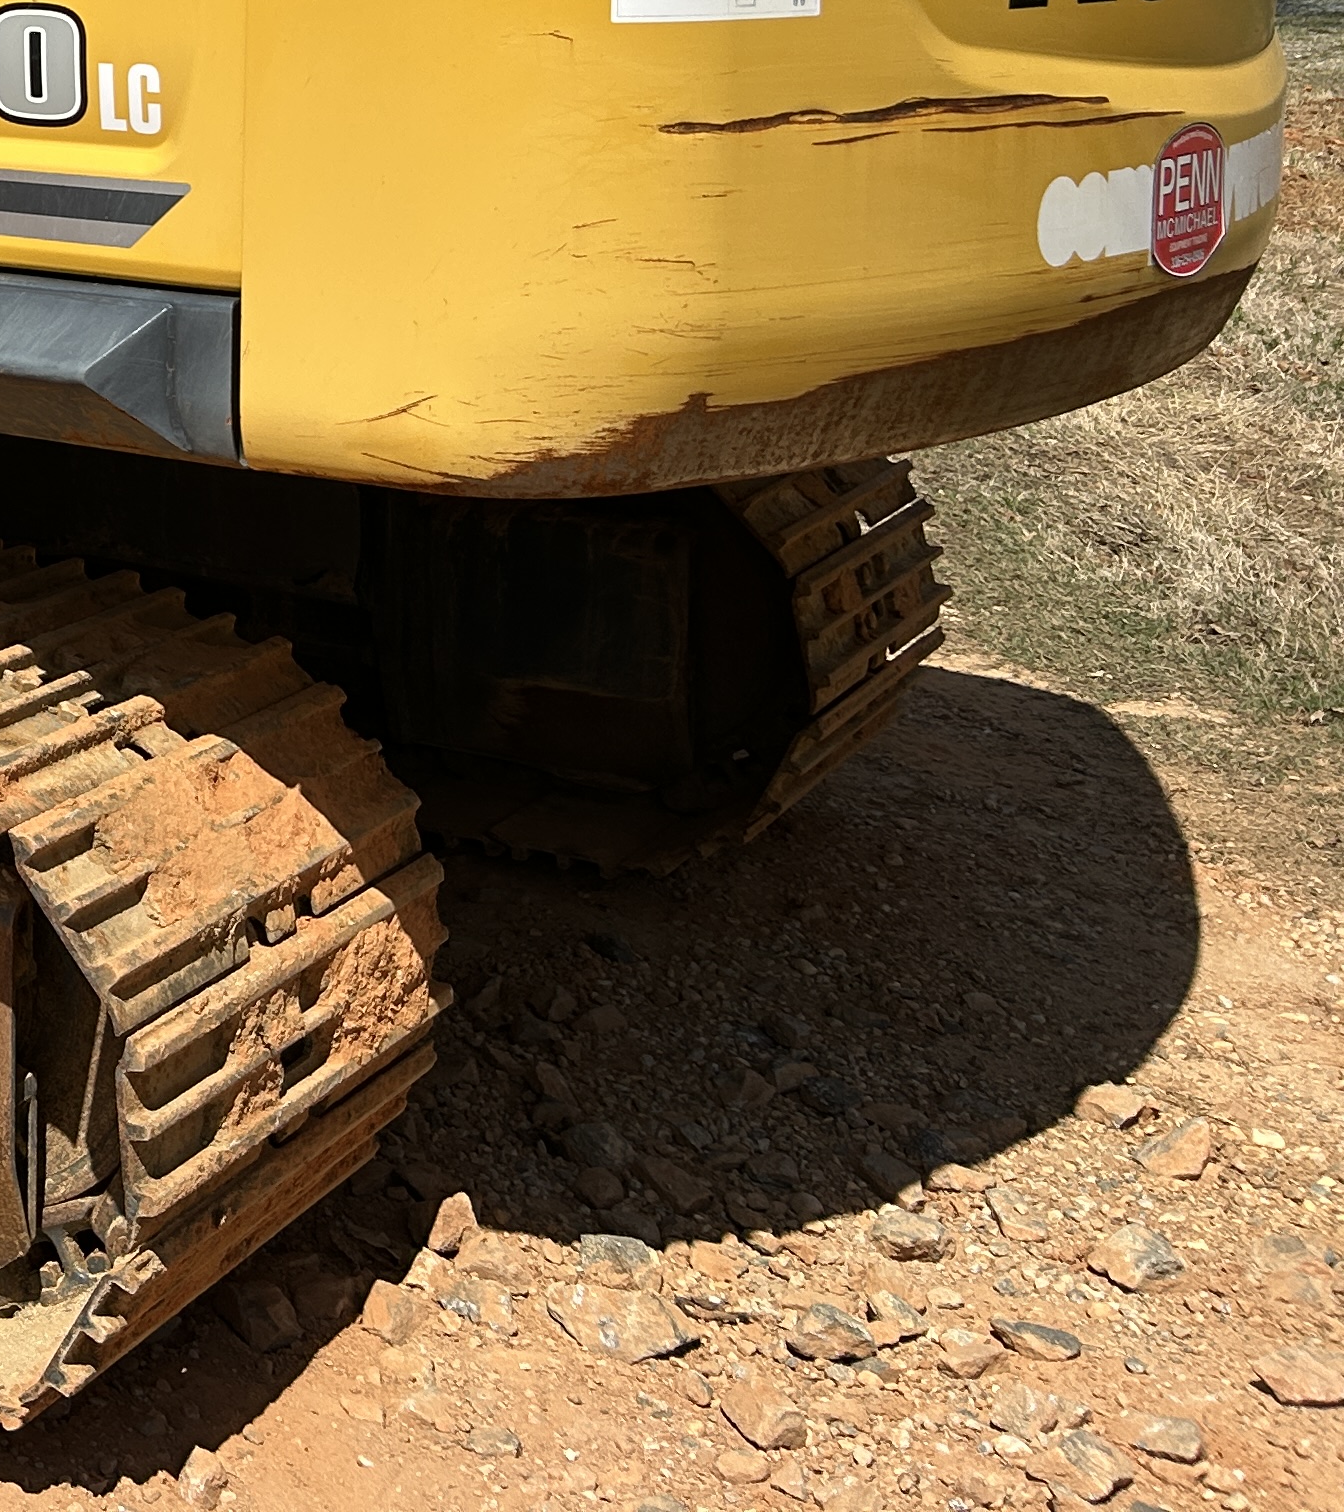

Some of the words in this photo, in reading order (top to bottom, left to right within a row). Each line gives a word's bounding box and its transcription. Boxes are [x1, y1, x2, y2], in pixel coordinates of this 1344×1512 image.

[97, 62, 162, 135] LC
[1158, 148, 1221, 216] PENN
[1156, 207, 1219, 240] MCMICHAEL
